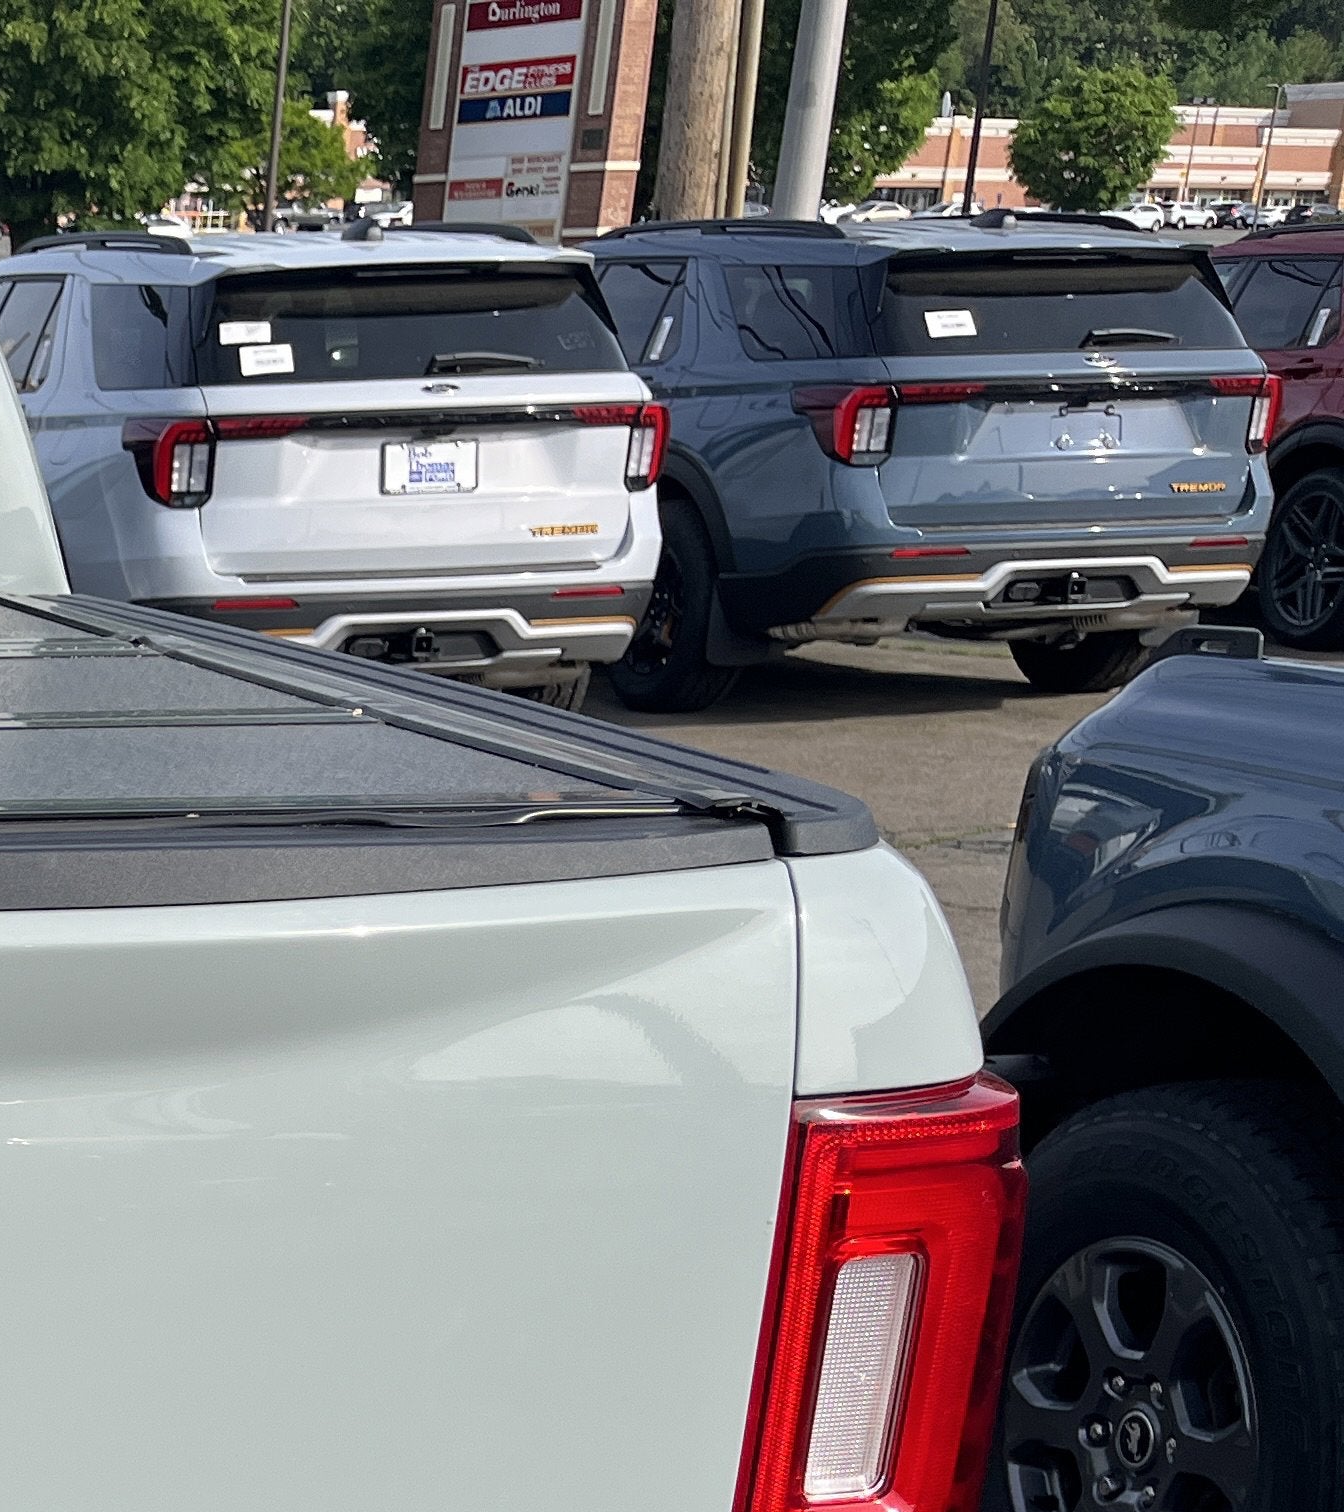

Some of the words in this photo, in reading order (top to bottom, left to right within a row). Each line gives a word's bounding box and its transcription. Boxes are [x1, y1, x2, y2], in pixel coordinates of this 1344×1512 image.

[487, 1, 561, 24] Burlington
[464, 67, 528, 94] EDGE
[502, 96, 543, 118] ALDI
